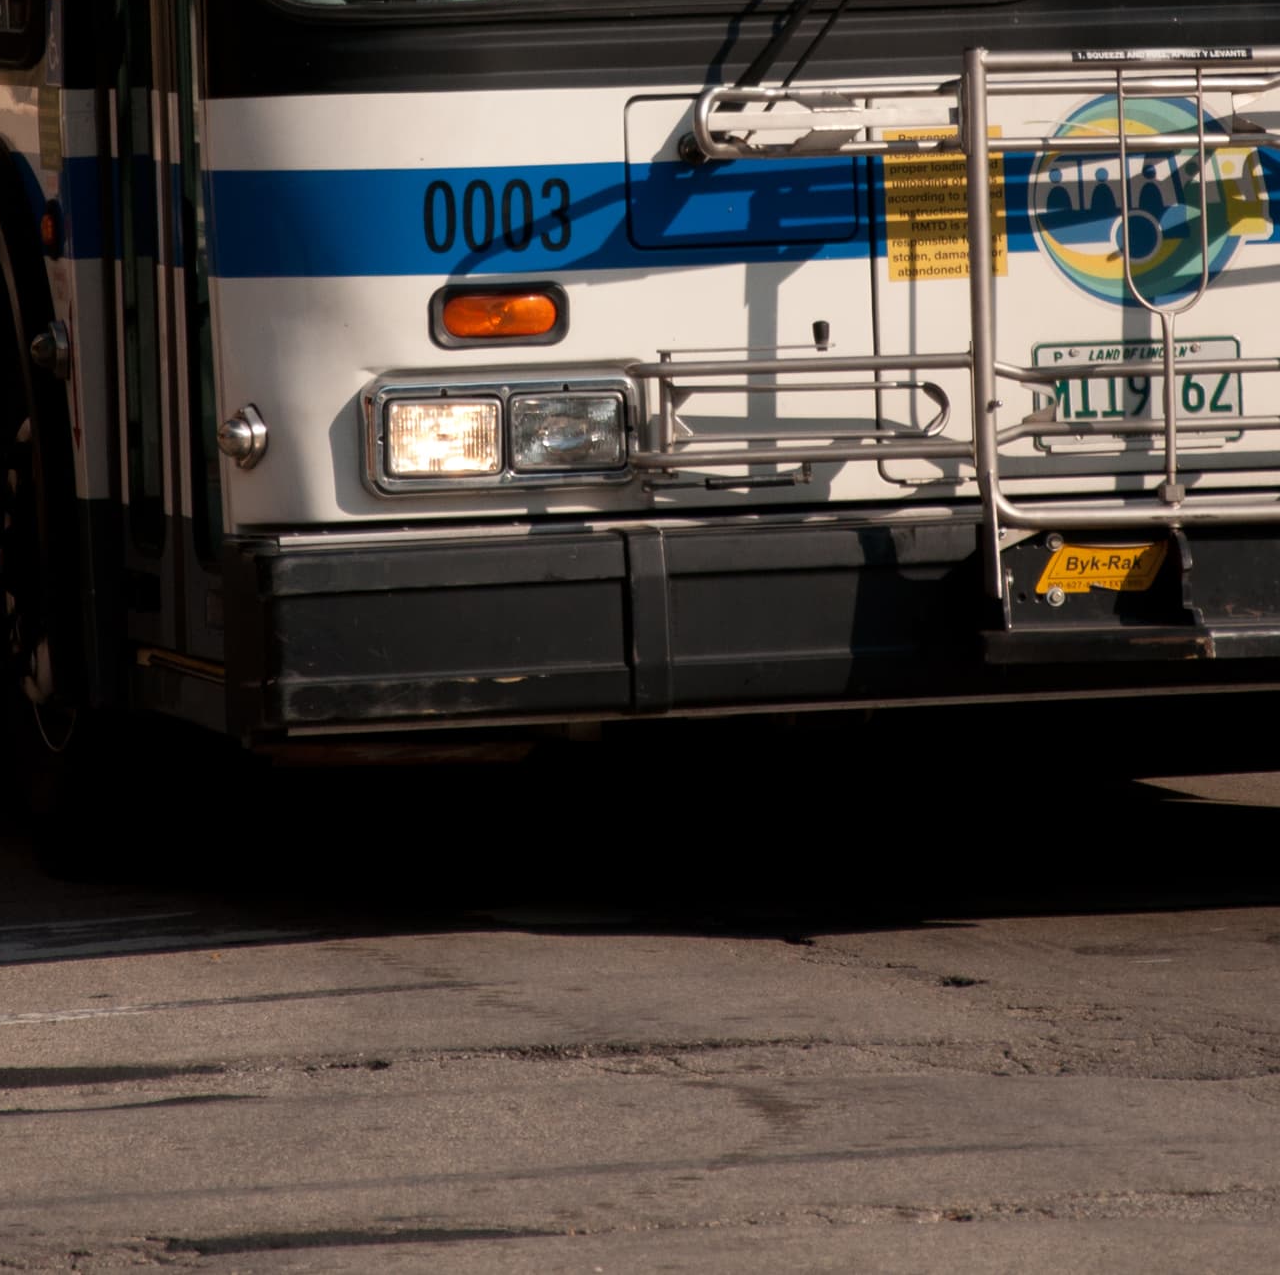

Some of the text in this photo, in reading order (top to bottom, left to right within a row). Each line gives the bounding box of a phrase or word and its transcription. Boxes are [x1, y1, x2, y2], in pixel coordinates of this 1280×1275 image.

[890, 163, 927, 175] proper
[888, 192, 945, 203] according
[949, 192, 960, 201] to
[423, 178, 572, 253] 0003
[912, 221, 947, 232] RMTD
[951, 221, 961, 229] is
[892, 235, 959, 248] responsible
[893, 252, 932, 263] stolen,
[898, 265, 962, 278] abandoned
[1088, 347, 1121, 362] LAND
[1123, 346, 1139, 360] OF
[1139, 343, 1188, 359] LINCLN
[1066, 554, 1143, 575] Byk-Rak
